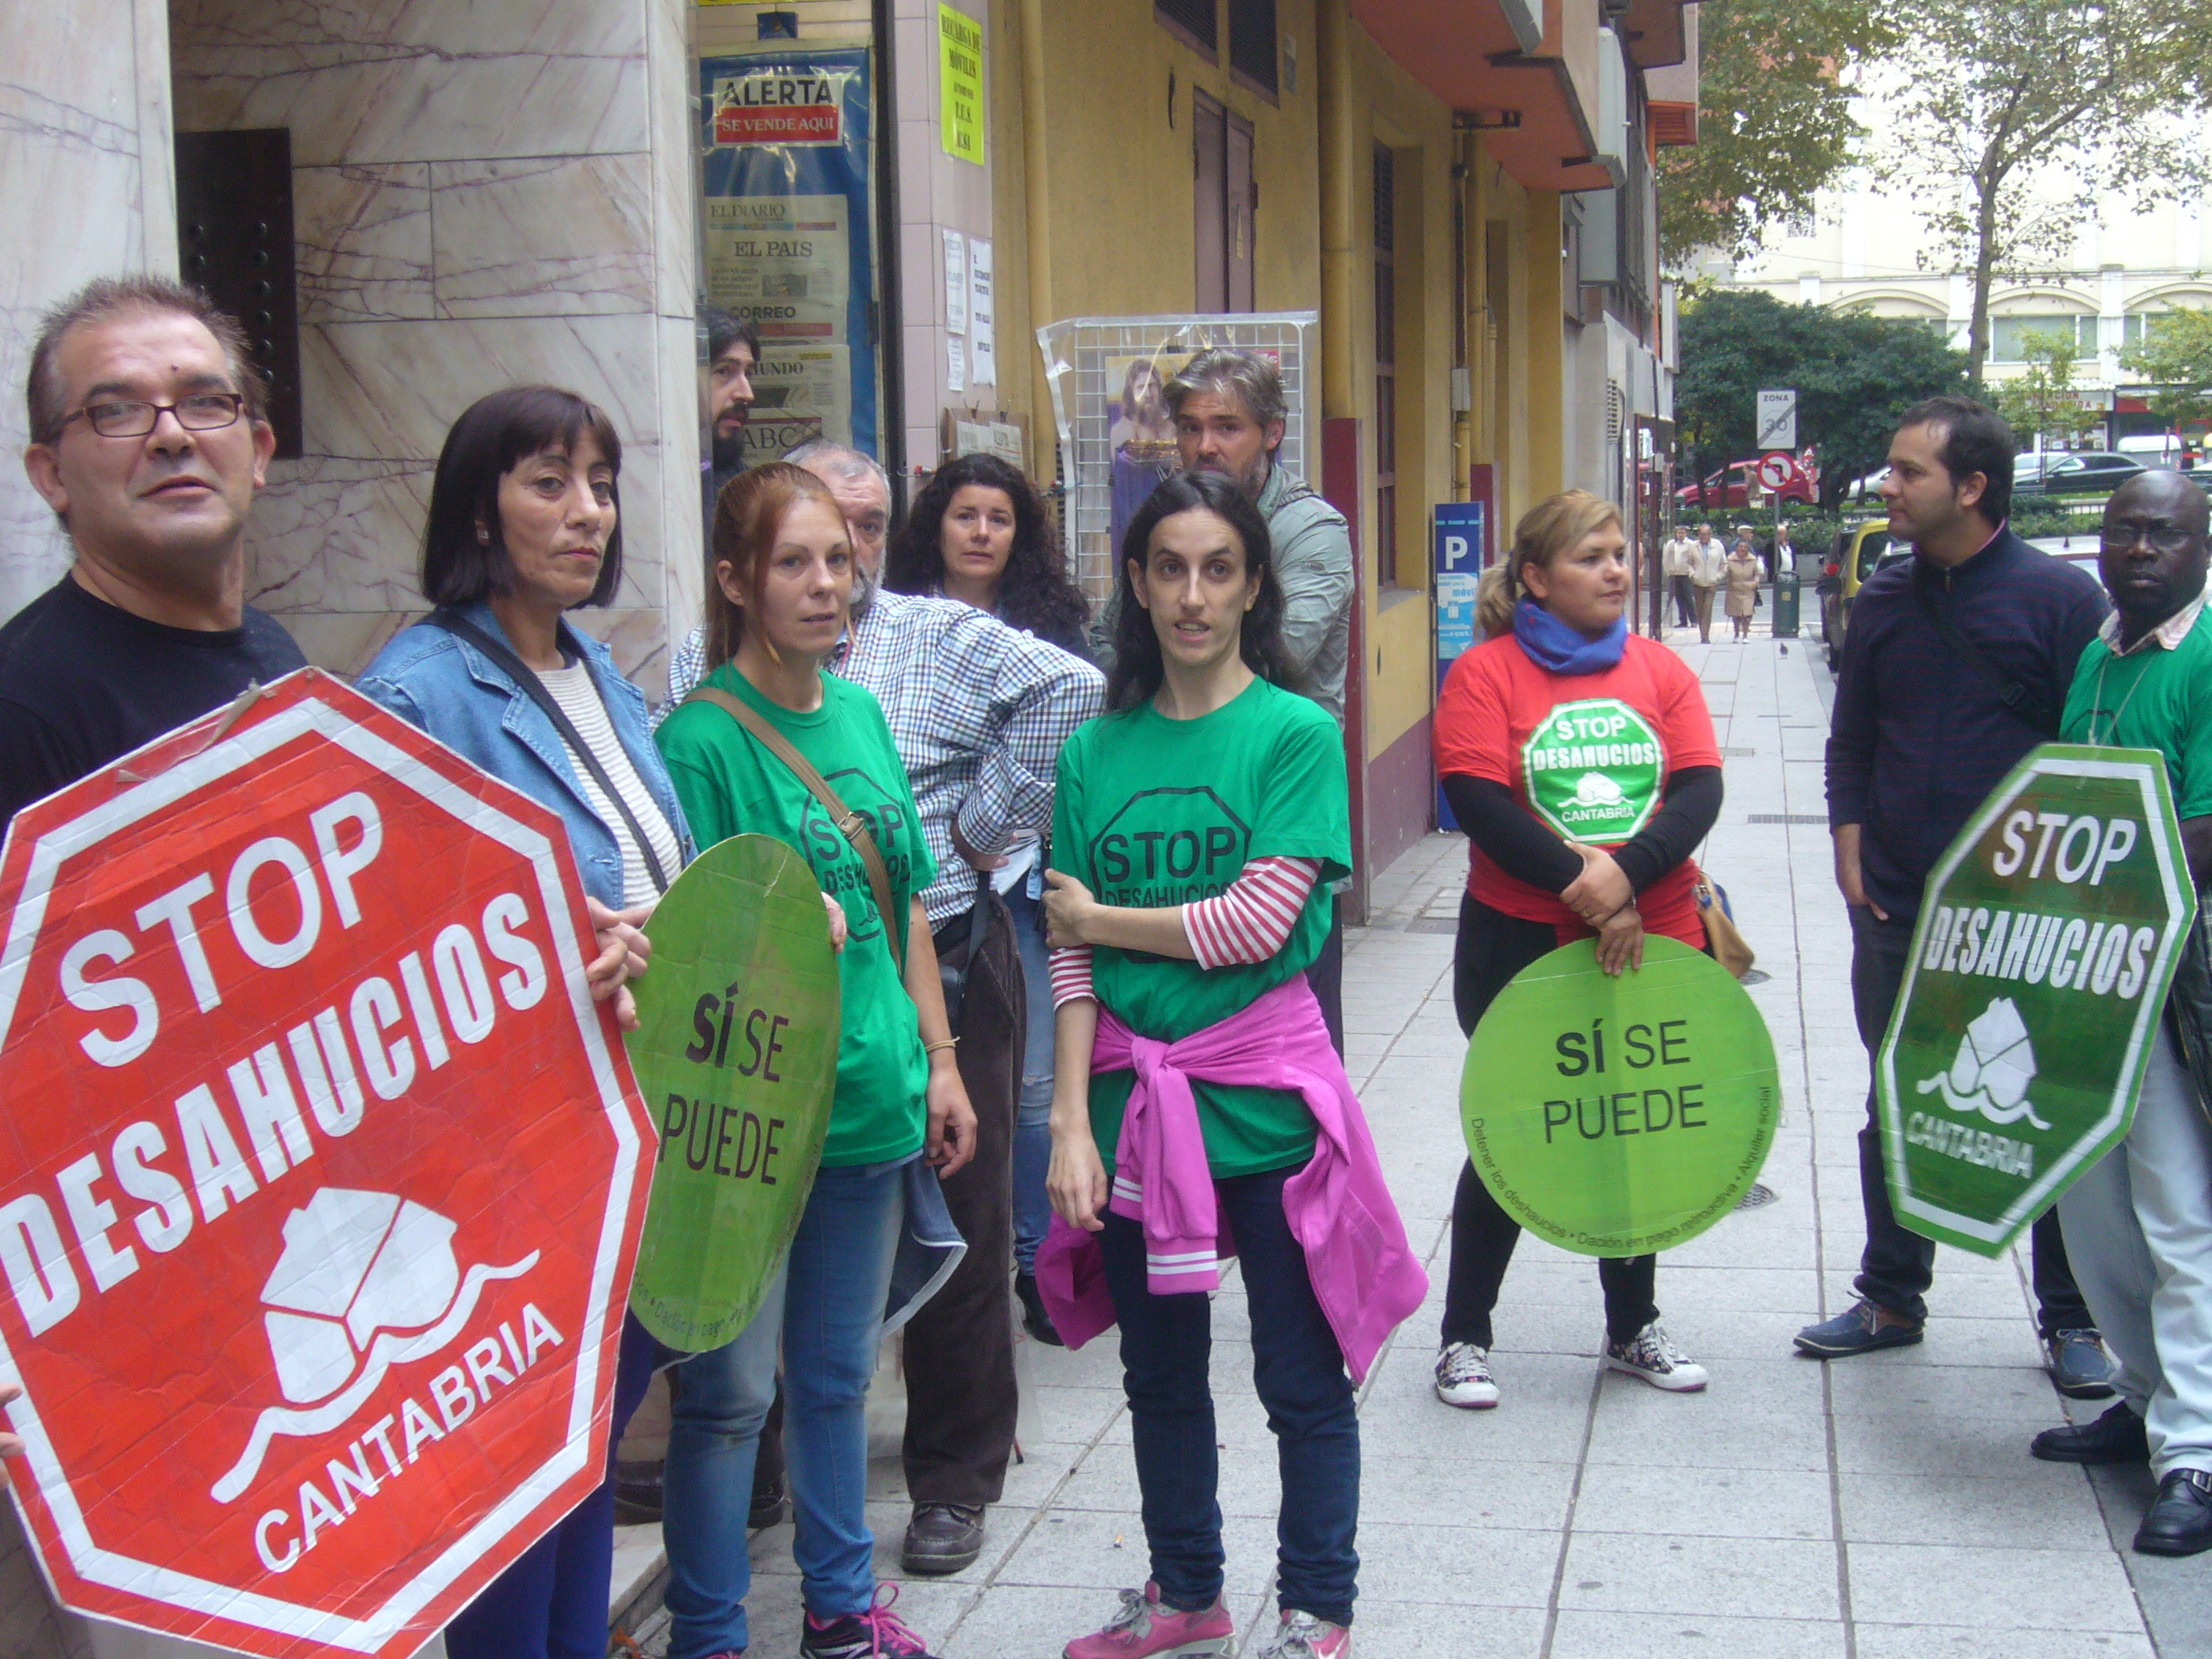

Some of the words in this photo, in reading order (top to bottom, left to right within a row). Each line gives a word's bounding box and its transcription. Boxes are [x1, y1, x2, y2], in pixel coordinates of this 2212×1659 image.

[723, 79, 833, 106] ALERTA
[722, 119, 742, 132] SE
[743, 119, 796, 131] VENDE
[798, 118, 835, 132] AQUI
[732, 203, 786, 218] DIARIO
[734, 241, 763, 258] EL
[1765, 418, 1789, 432] 30
[1445, 536, 1468, 570] P
[1533, 742, 1656, 771] DESAHUCIOS
[1556, 716, 1628, 741] STOP
[808, 804, 904, 861] SOP
[1561, 806, 1636, 822] CANTABRIA
[1101, 826, 1236, 884] STOP
[1992, 809, 2137, 887] STOP
[59, 790, 384, 1068] STOP
[1922, 906, 2155, 1002] DESAHUCIOS
[685, 980, 740, 1070] SÍ
[738, 1008, 789, 1083] SE
[1555, 1018, 1606, 1077] SÍ
[1624, 1020, 1691, 1069] SE
[0, 892, 548, 1339] DESAHUCIOS
[658, 1093, 786, 1186] PUEDE
[1544, 1083, 1708, 1144] PUEDE
[1471, 1118, 1496, 1169] Detener
[1906, 1110, 2036, 1180] CANTABRIA
[254, 1301, 566, 1573] CANTABRIA
